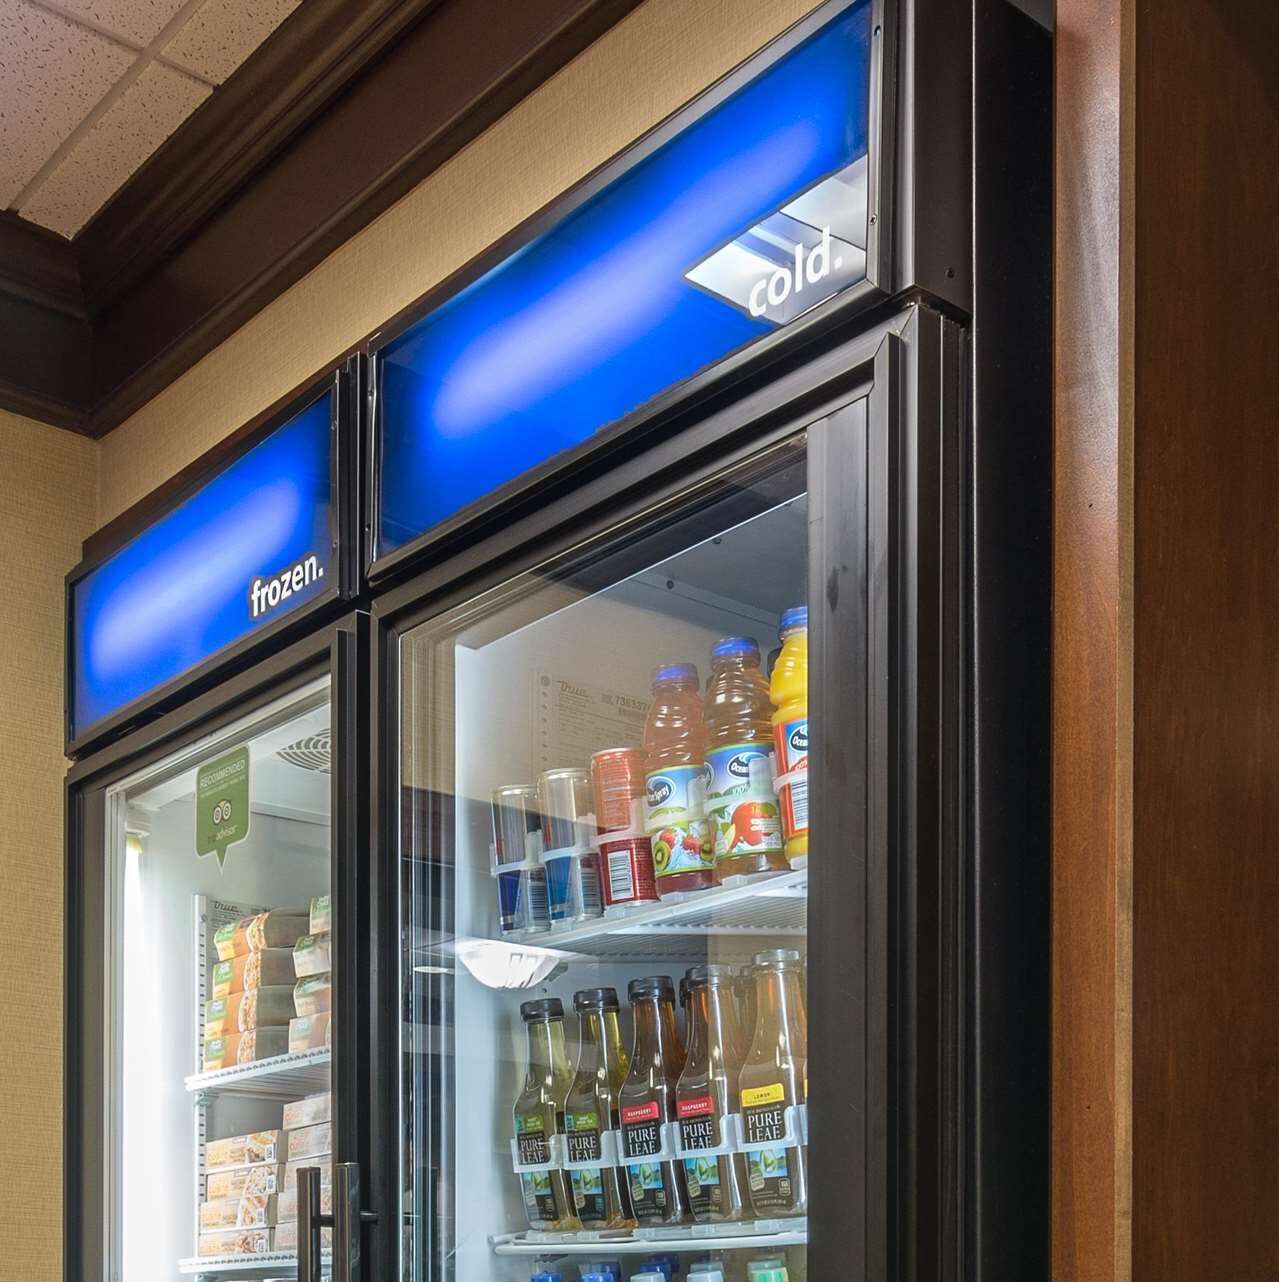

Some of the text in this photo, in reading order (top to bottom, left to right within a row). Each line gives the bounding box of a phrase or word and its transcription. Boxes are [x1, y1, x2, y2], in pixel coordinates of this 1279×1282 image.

[748, 226, 843, 318] cold.
[250, 550, 324, 618] frozen.
[748, 1111, 782, 1128] PURE
[628, 1127, 657, 1143] PURE
[683, 1122, 713, 1138] PURE
[749, 1125, 781, 1142] LEAF
[520, 1137, 544, 1151] PURE
[569, 1136, 597, 1149] PURE
[629, 1141, 656, 1156] LEAF
[521, 1151, 544, 1164] LEAF
[570, 1150, 596, 1162] LEAF
